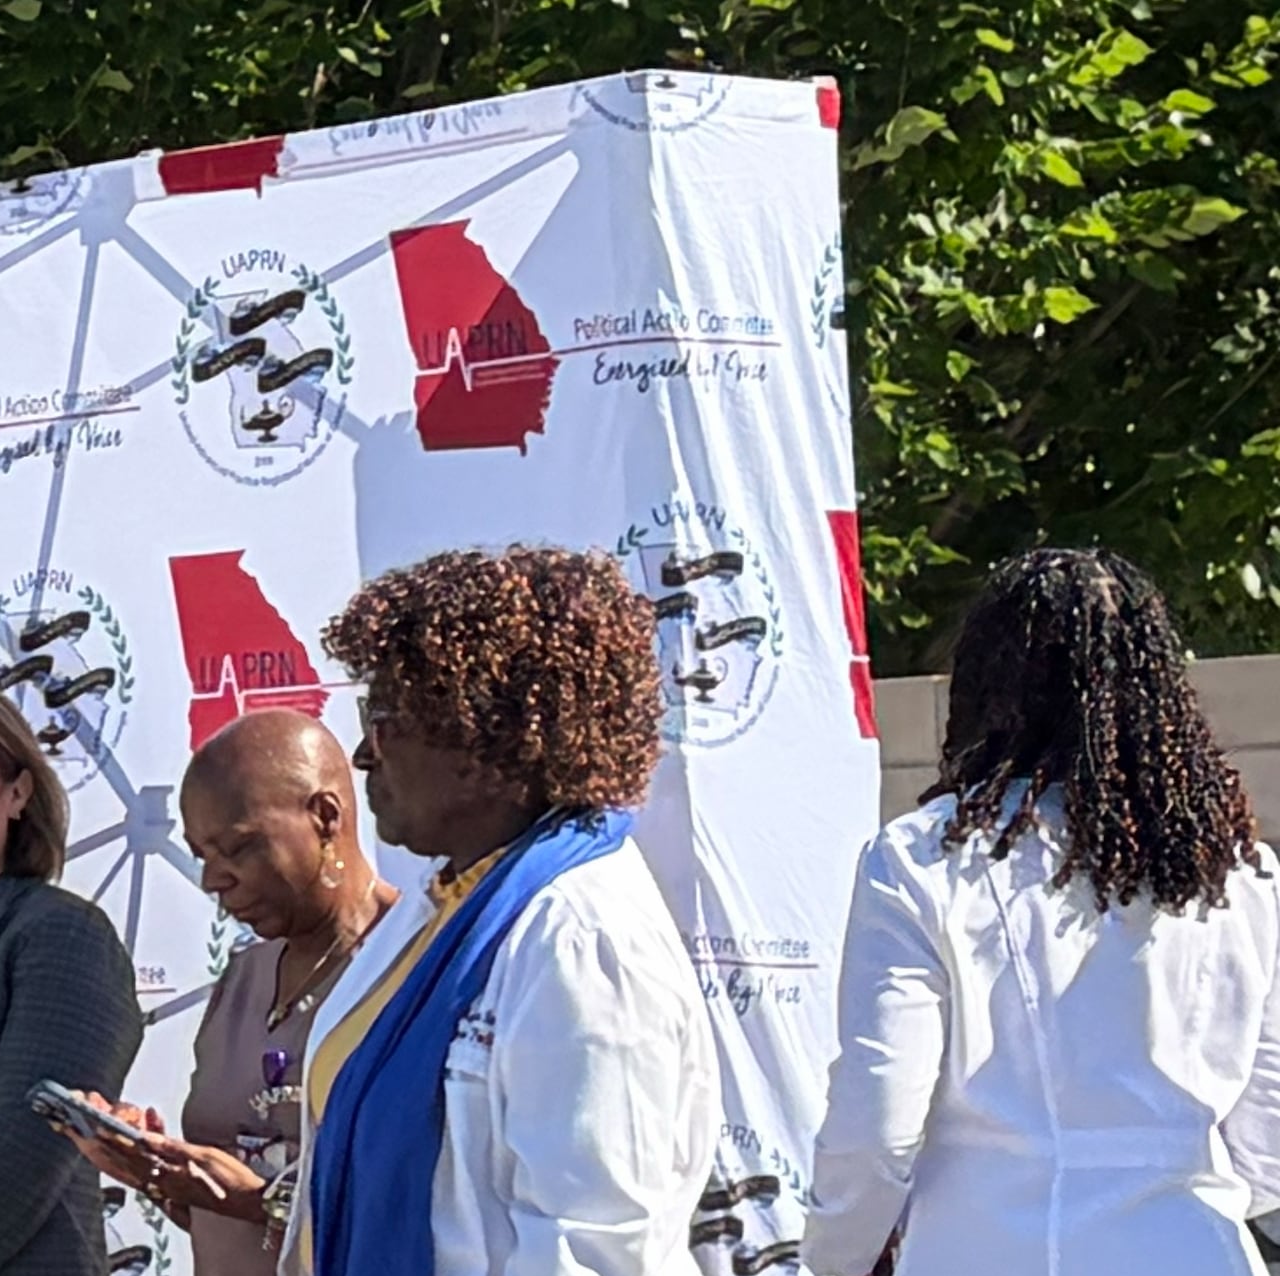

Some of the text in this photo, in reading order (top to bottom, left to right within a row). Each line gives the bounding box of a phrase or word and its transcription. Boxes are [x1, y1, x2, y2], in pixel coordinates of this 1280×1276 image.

[221, 250, 286, 278] UAPRN
[574, 311, 636, 341] Political
[422, 319, 526, 365] UAPRN
[5, 396, 48, 419] Action
[12, 568, 75, 597] UAPRN
[197, 649, 298, 693] UAPRN
[719, 1122, 766, 1158] PRN
